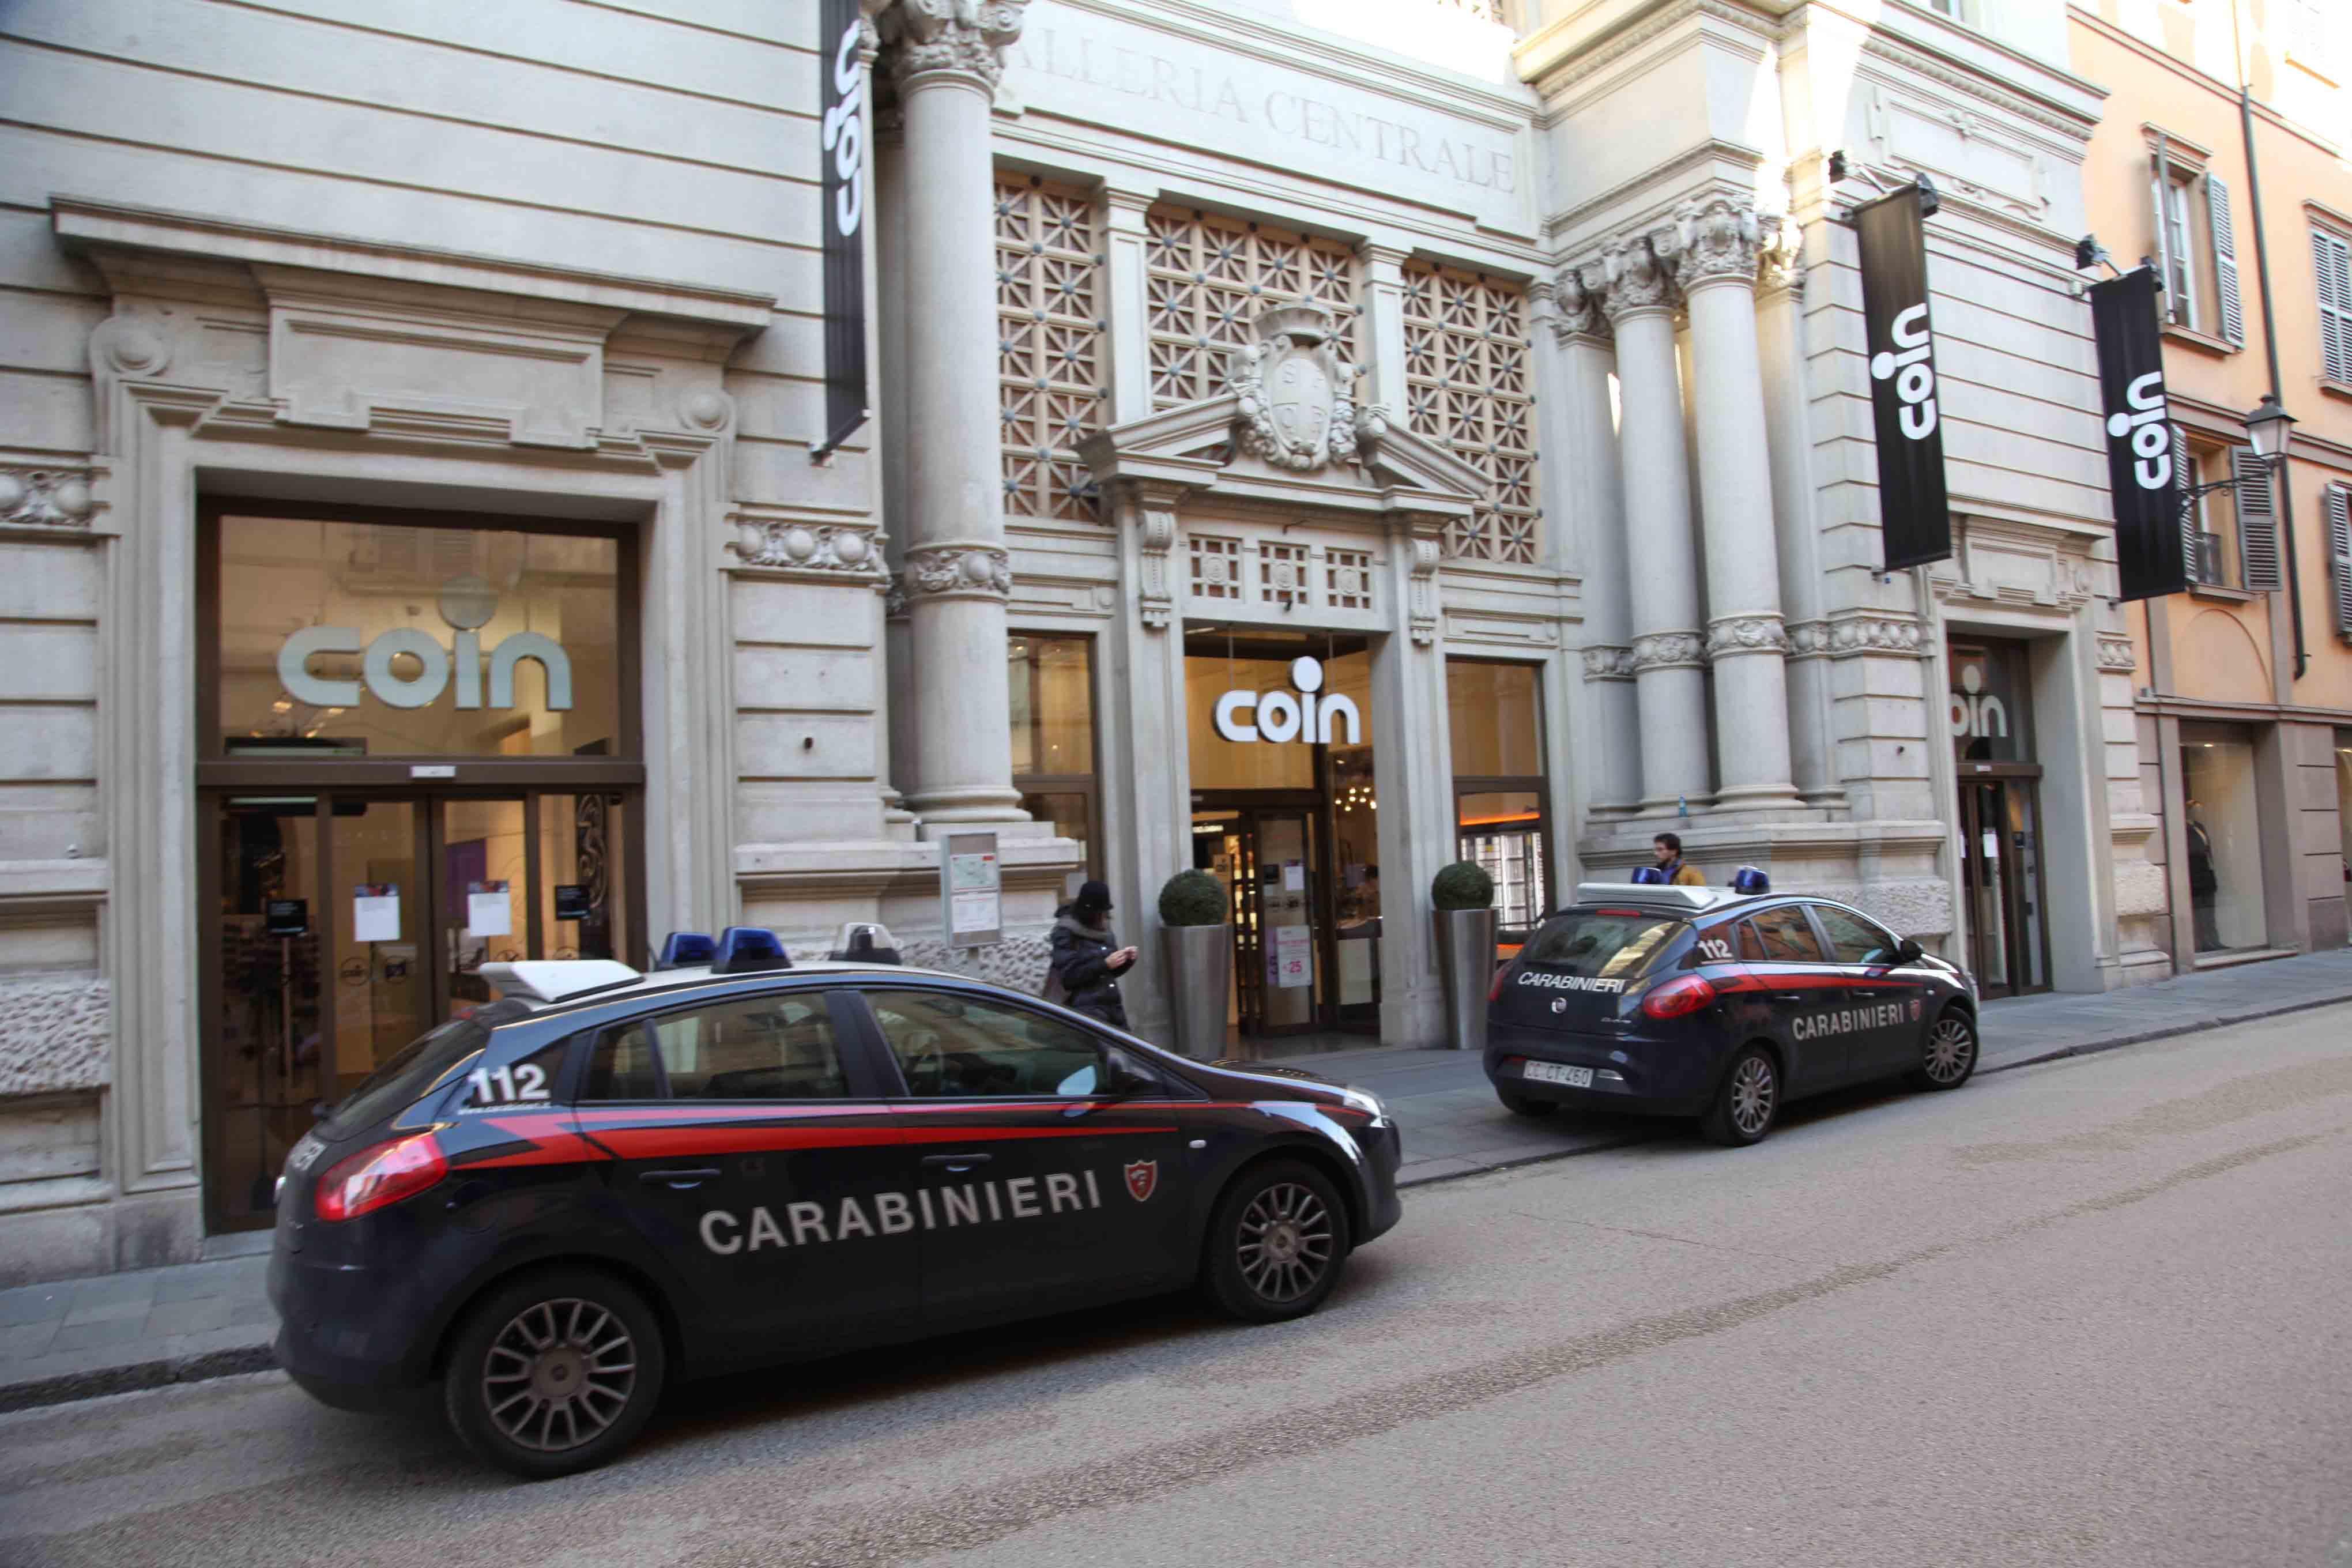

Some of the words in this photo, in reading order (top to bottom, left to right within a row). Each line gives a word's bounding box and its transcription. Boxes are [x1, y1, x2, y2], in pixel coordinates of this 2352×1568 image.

[823, 18, 863, 236] coin
[1265, 90, 1516, 194] CENTRALE
[1871, 303, 1937, 440] coin
[2108, 371, 2172, 489] coin
[277, 575, 573, 711] coin
[1214, 655, 1360, 744] coin
[1950, 665, 2008, 737] oin
[1518, 971, 1625, 993] CARABINIERI
[1697, 939, 1733, 959] 112
[1792, 1002, 1904, 1040] CARABINIERI
[468, 1063, 551, 1103] 112
[699, 1169, 1102, 1256] CARABINIERI
